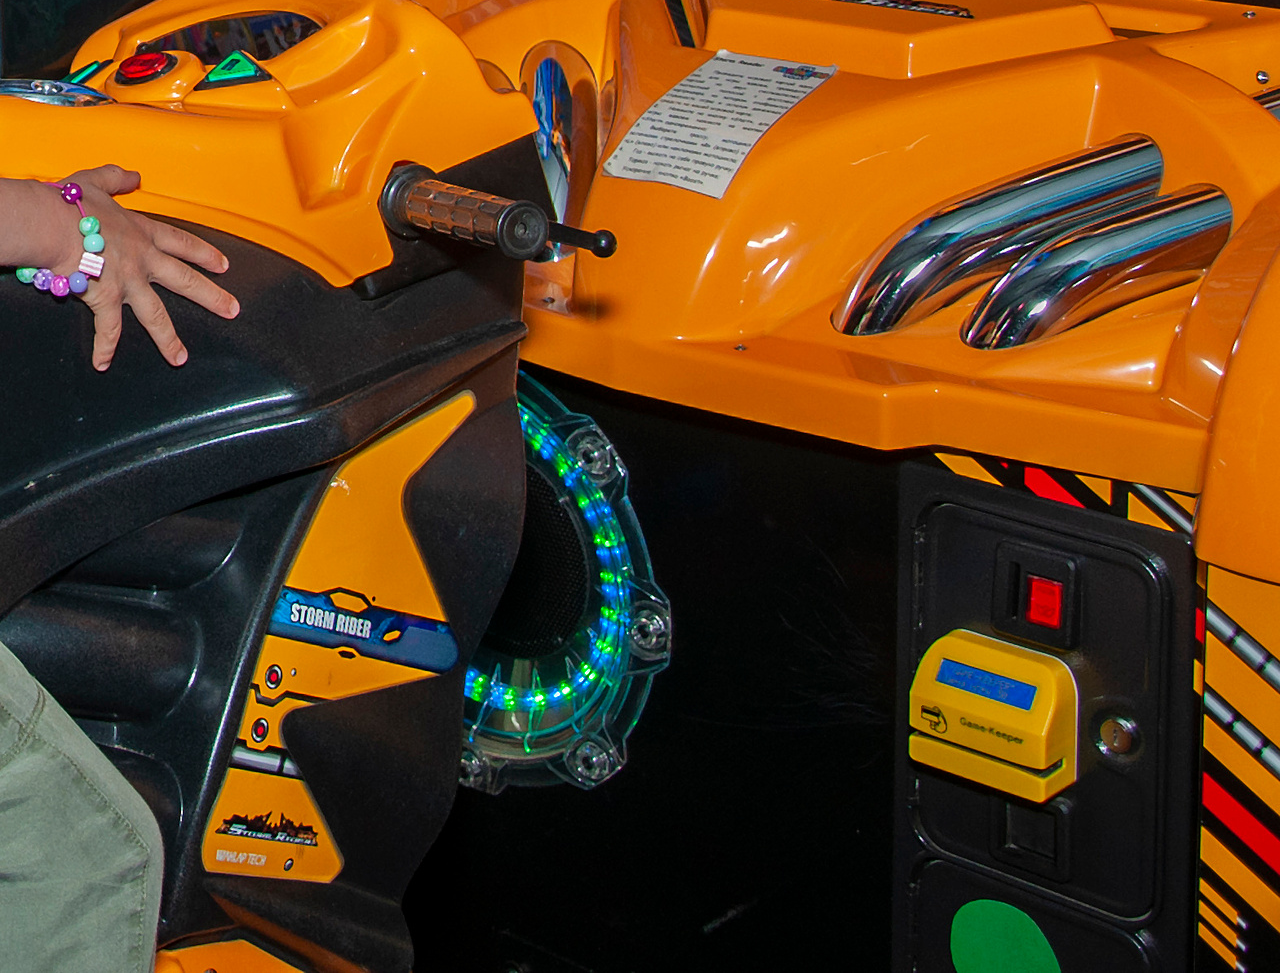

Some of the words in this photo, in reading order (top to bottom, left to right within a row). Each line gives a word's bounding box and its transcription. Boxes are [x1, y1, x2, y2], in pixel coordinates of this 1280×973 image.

[291, 602, 335, 631] STORM
[336, 613, 372, 639] RIDER
[960, 717, 1024, 745] Game-Keeper
